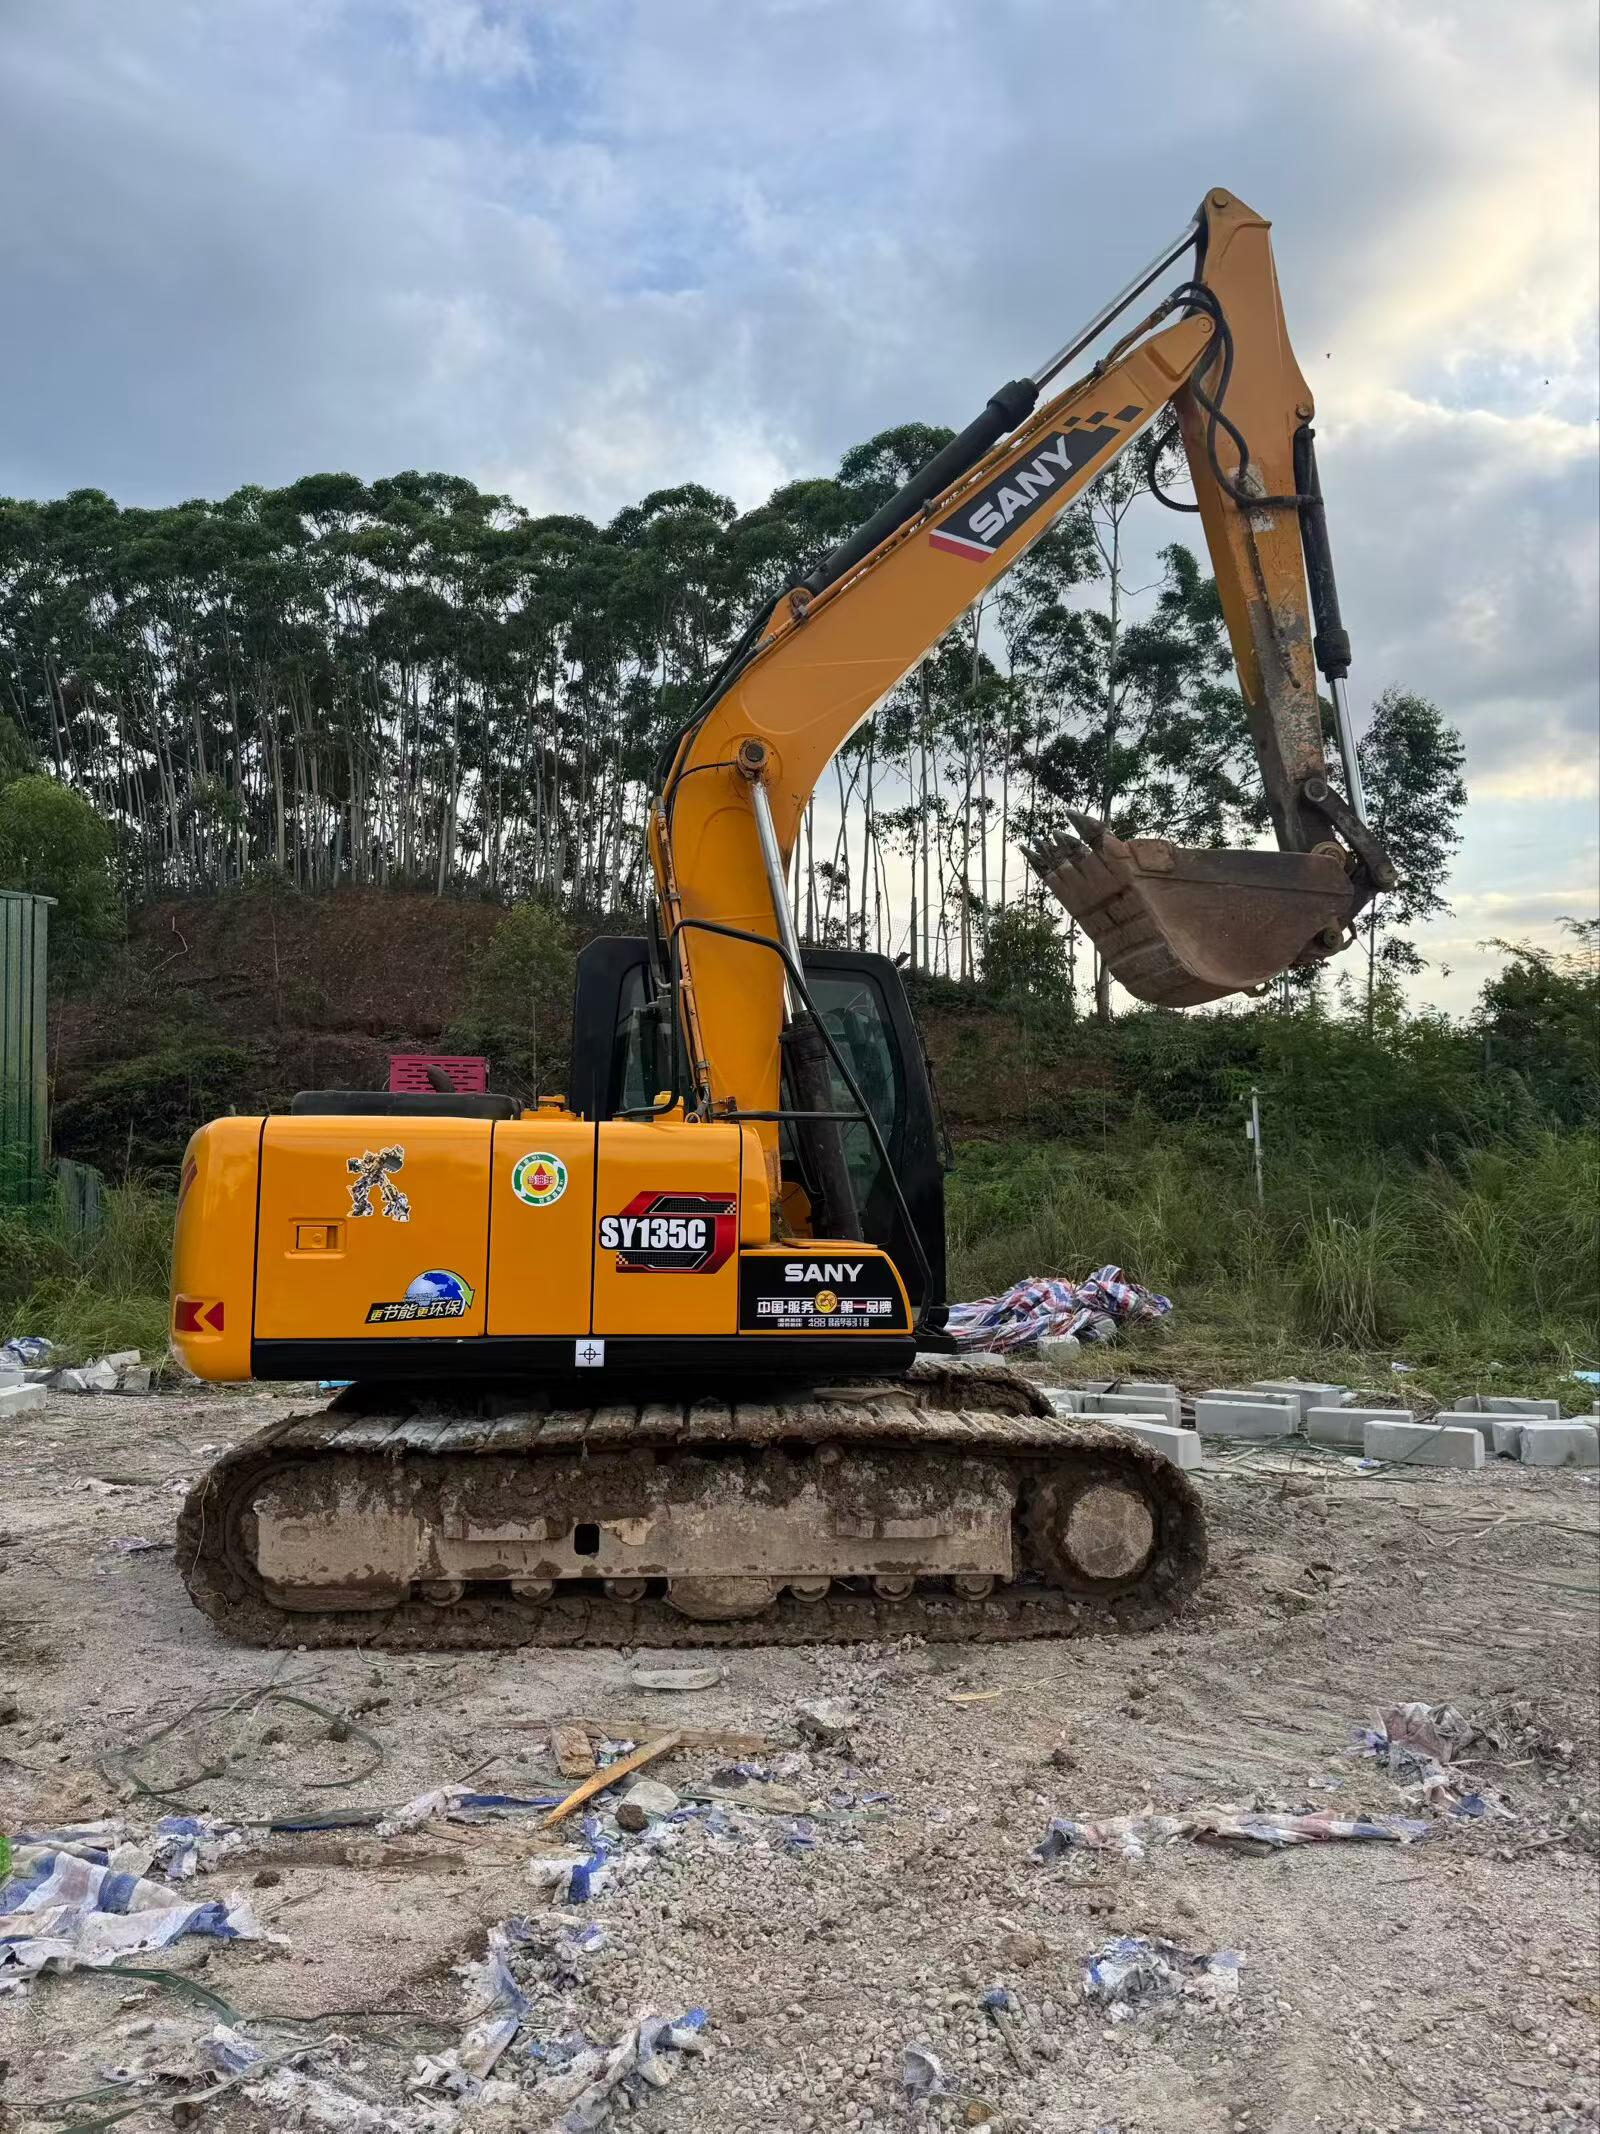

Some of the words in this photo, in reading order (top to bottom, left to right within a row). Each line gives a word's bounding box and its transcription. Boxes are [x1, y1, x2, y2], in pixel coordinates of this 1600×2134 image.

[969, 436, 1073, 543] SANY
[601, 1217, 706, 1249] SY135C
[784, 1263, 864, 1282] SANY
[368, 1300, 461, 1322] 更节能更环保
[841, 1301, 892, 1314] 第一品牌
